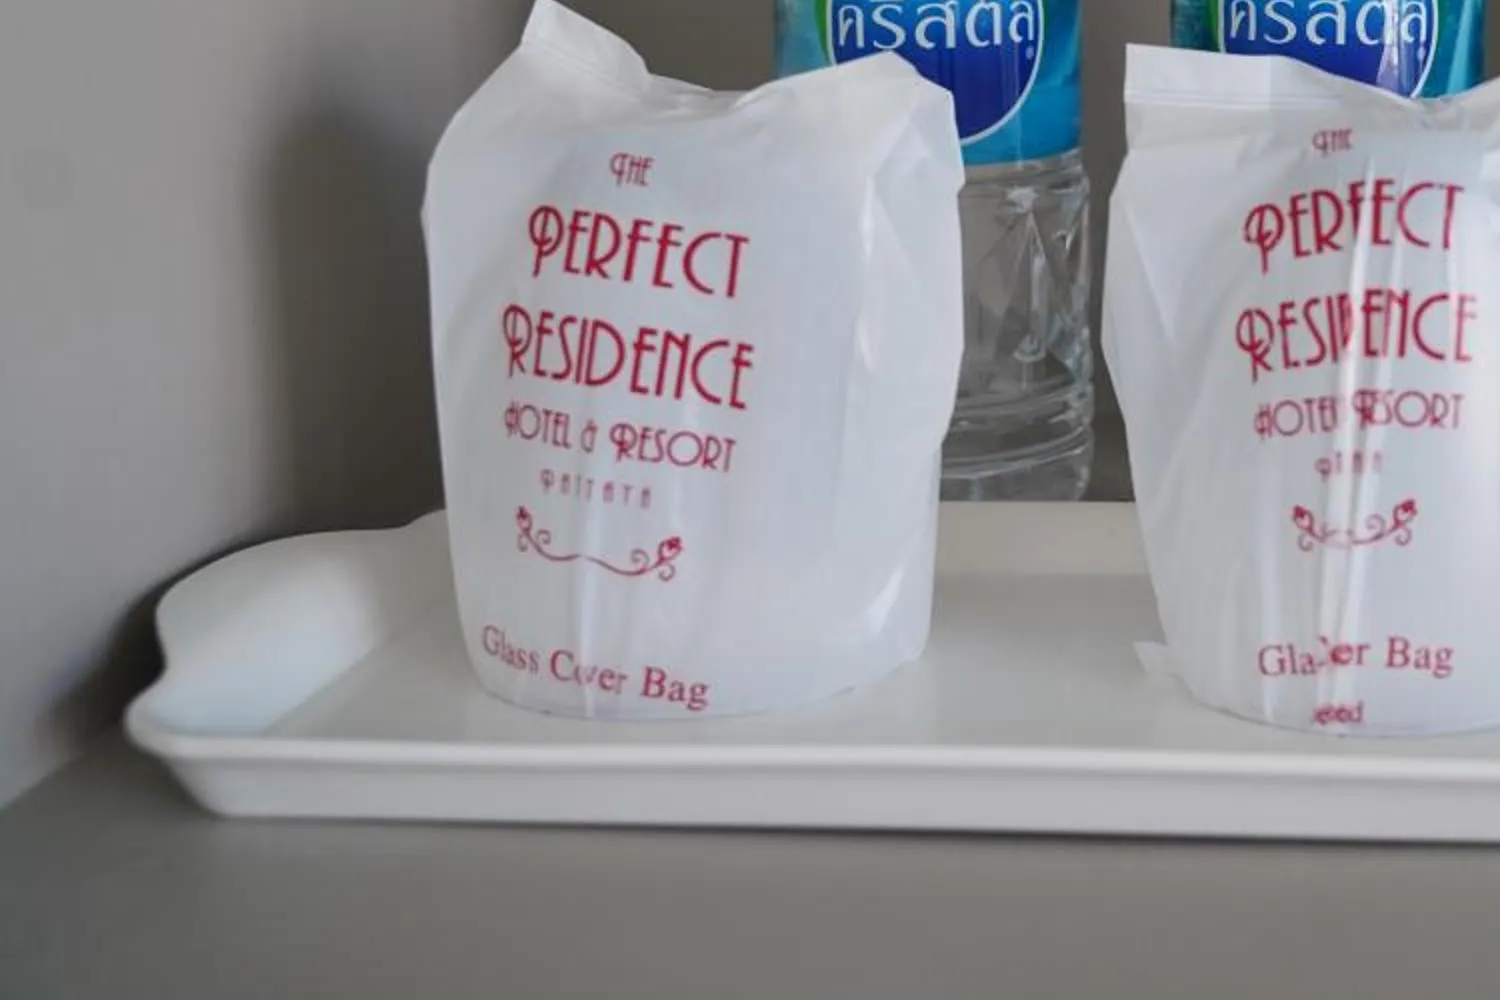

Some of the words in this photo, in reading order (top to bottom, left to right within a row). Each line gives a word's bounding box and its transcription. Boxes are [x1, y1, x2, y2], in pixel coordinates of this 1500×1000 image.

[610, 151, 655, 187] THE
[527, 204, 751, 299] PERFECT
[1243, 177, 1466, 277] PERFECT
[502, 303, 756, 412] RESIDENCE
[504, 400, 573, 449] HOTEL
[608, 420, 737, 473] RESORT
[481, 623, 541, 676] Glass
[640, 662, 713, 712] Bag
[1384, 633, 1456, 679] Bag
